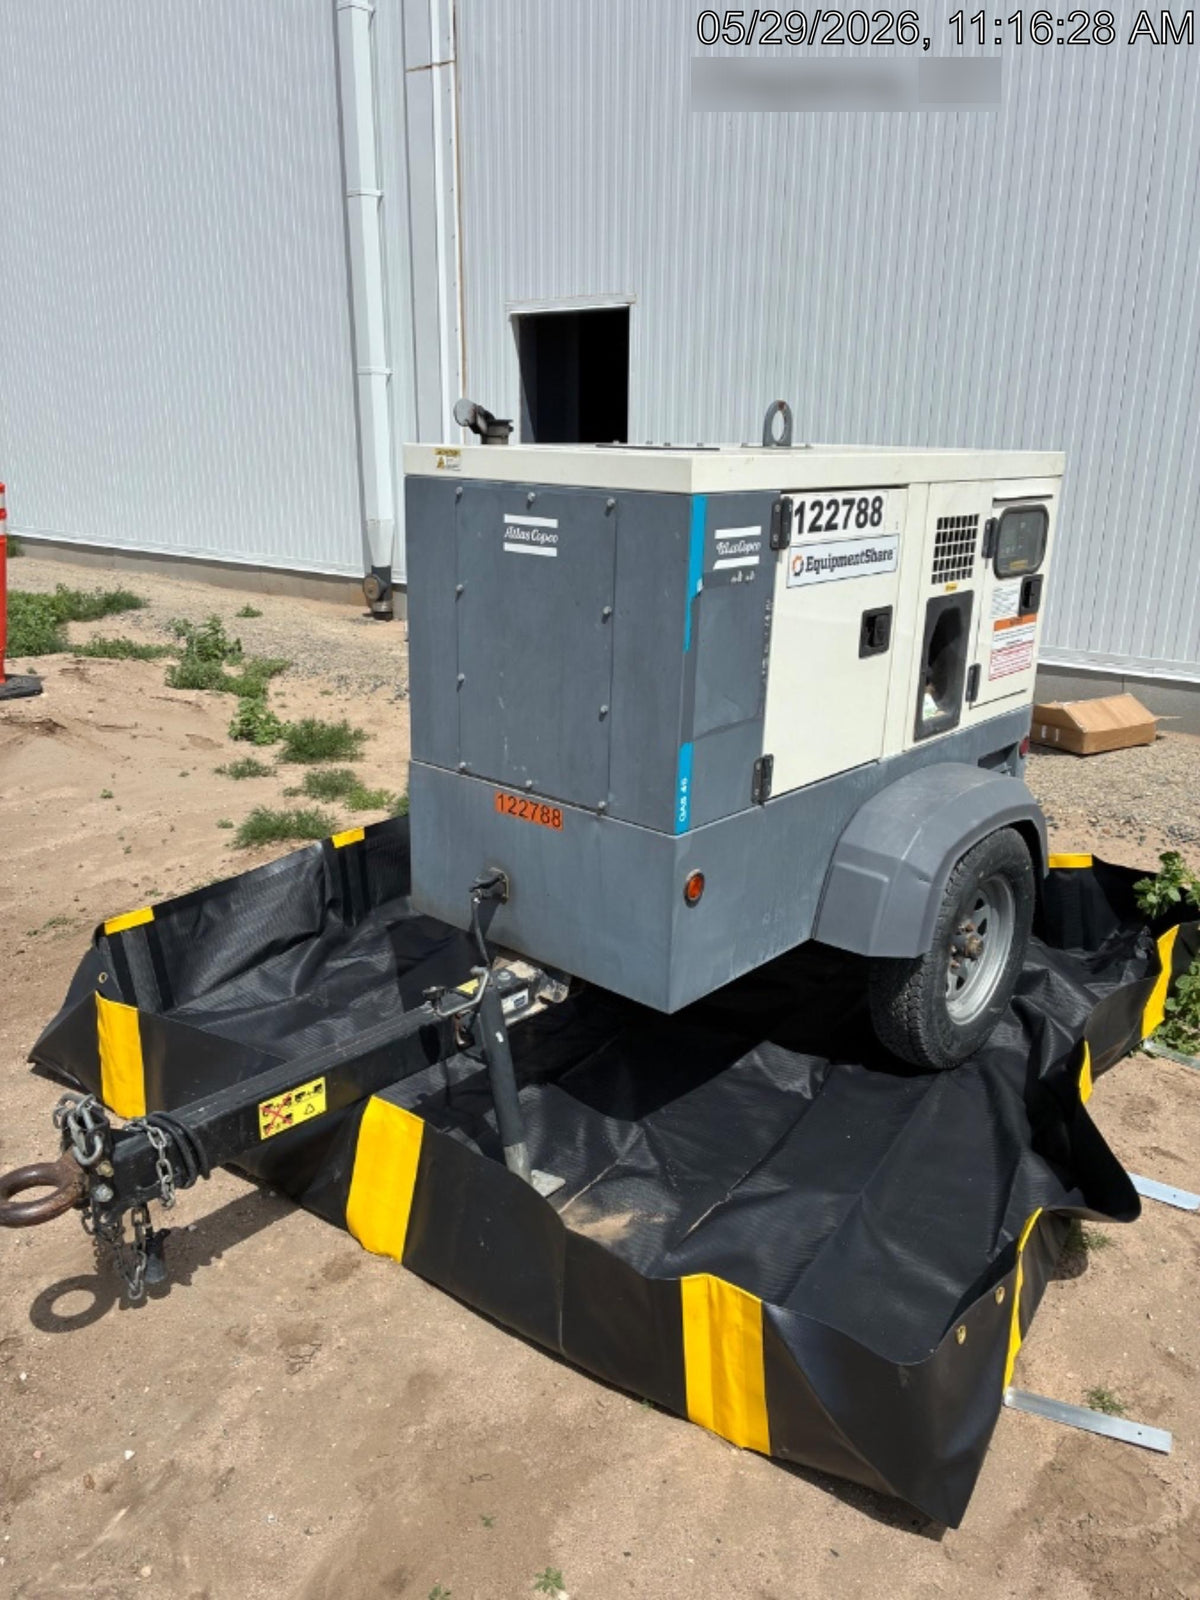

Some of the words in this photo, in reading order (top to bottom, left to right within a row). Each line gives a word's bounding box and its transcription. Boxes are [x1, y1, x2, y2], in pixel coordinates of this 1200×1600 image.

[794, 495, 884, 534] 122788
[504, 525, 530, 541] Atlas
[530, 528, 559, 544] Copco
[805, 547, 894, 575] EquipmentShare
[497, 794, 562, 829] 122788
